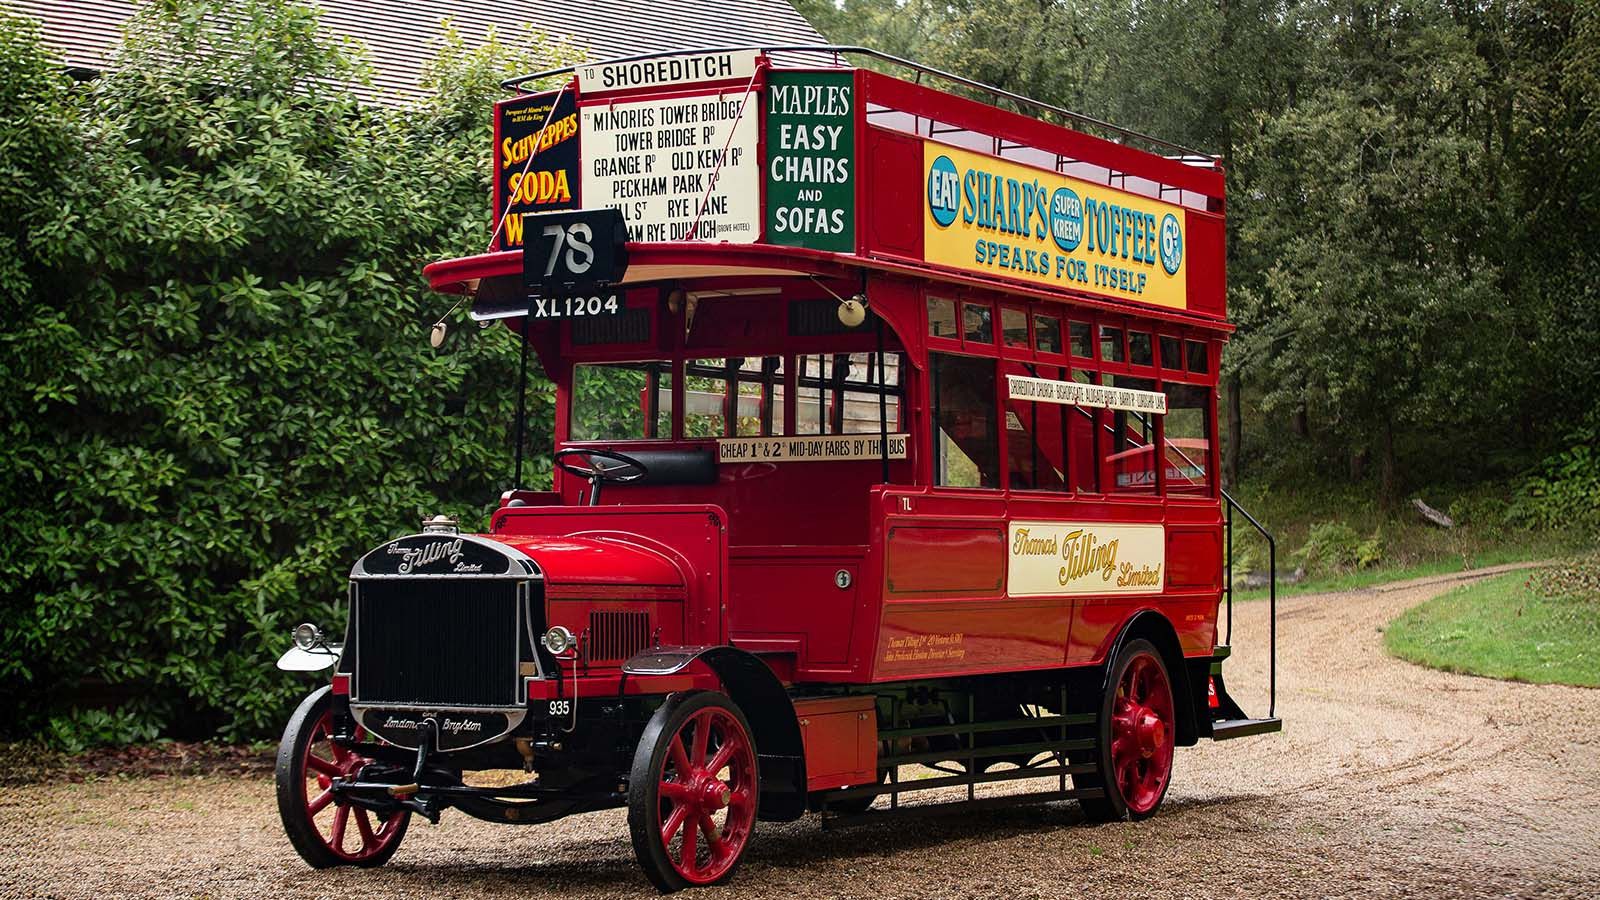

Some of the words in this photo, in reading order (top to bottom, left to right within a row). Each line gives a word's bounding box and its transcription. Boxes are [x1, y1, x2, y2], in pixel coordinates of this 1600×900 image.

[584, 68, 595, 80] TO
[602, 55, 732, 88] SHOREDITCH
[770, 84, 850, 116] MAPLES
[593, 107, 654, 132] MINORIES
[660, 104, 698, 126] TOWER
[702, 100, 743, 122] BRIDGE
[502, 113, 578, 170] SCHWEPPES
[615, 131, 653, 152] TOWER
[657, 127, 697, 149] BRIDGE
[780, 124, 843, 151] EASY
[594, 155, 640, 177] GRANGE
[672, 151, 694, 171] OLD
[697, 148, 728, 169] KENT
[771, 155, 849, 183] CHAIRS
[507, 169, 571, 205] SODA
[613, 176, 667, 199] PECKHAM
[673, 174, 703, 195] PARK
[797, 189, 823, 201] AND
[667, 199, 689, 218] RYE
[695, 195, 728, 217] LANE
[774, 206, 845, 234] SOFAS
[931, 168, 959, 212] EAT
[963, 168, 1049, 241] SHARP'S
[1085, 196, 1156, 266] TOFFEE
[1054, 194, 1081, 219] SUPER
[647, 223, 666, 241] RYE
[1053, 217, 1081, 243] KREEM
[542, 222, 595, 277] 78
[975, 239, 1050, 276] SPEAKS
[1056, 255, 1088, 284] FOR
[1094, 263, 1147, 294] ITSELF
[721, 443, 748, 458] CHEAP
[763, 442, 771, 457] &
[789, 440, 824, 457] MID-DAY
[825, 440, 850, 456] FARES
[854, 440, 865, 456] BY
[889, 438, 905, 454] BUS
[902, 497, 912, 511] TL
[398, 538, 464, 574] Tilling
[453, 561, 483, 572] Limited
[1012, 527, 1058, 556] Thomas
[1058, 528, 1119, 586] Tilling
[1116, 561, 1161, 587] Limited
[548, 700, 570, 715] 935
[383, 715, 418, 730] London
[442, 718, 482, 735] Brighton
